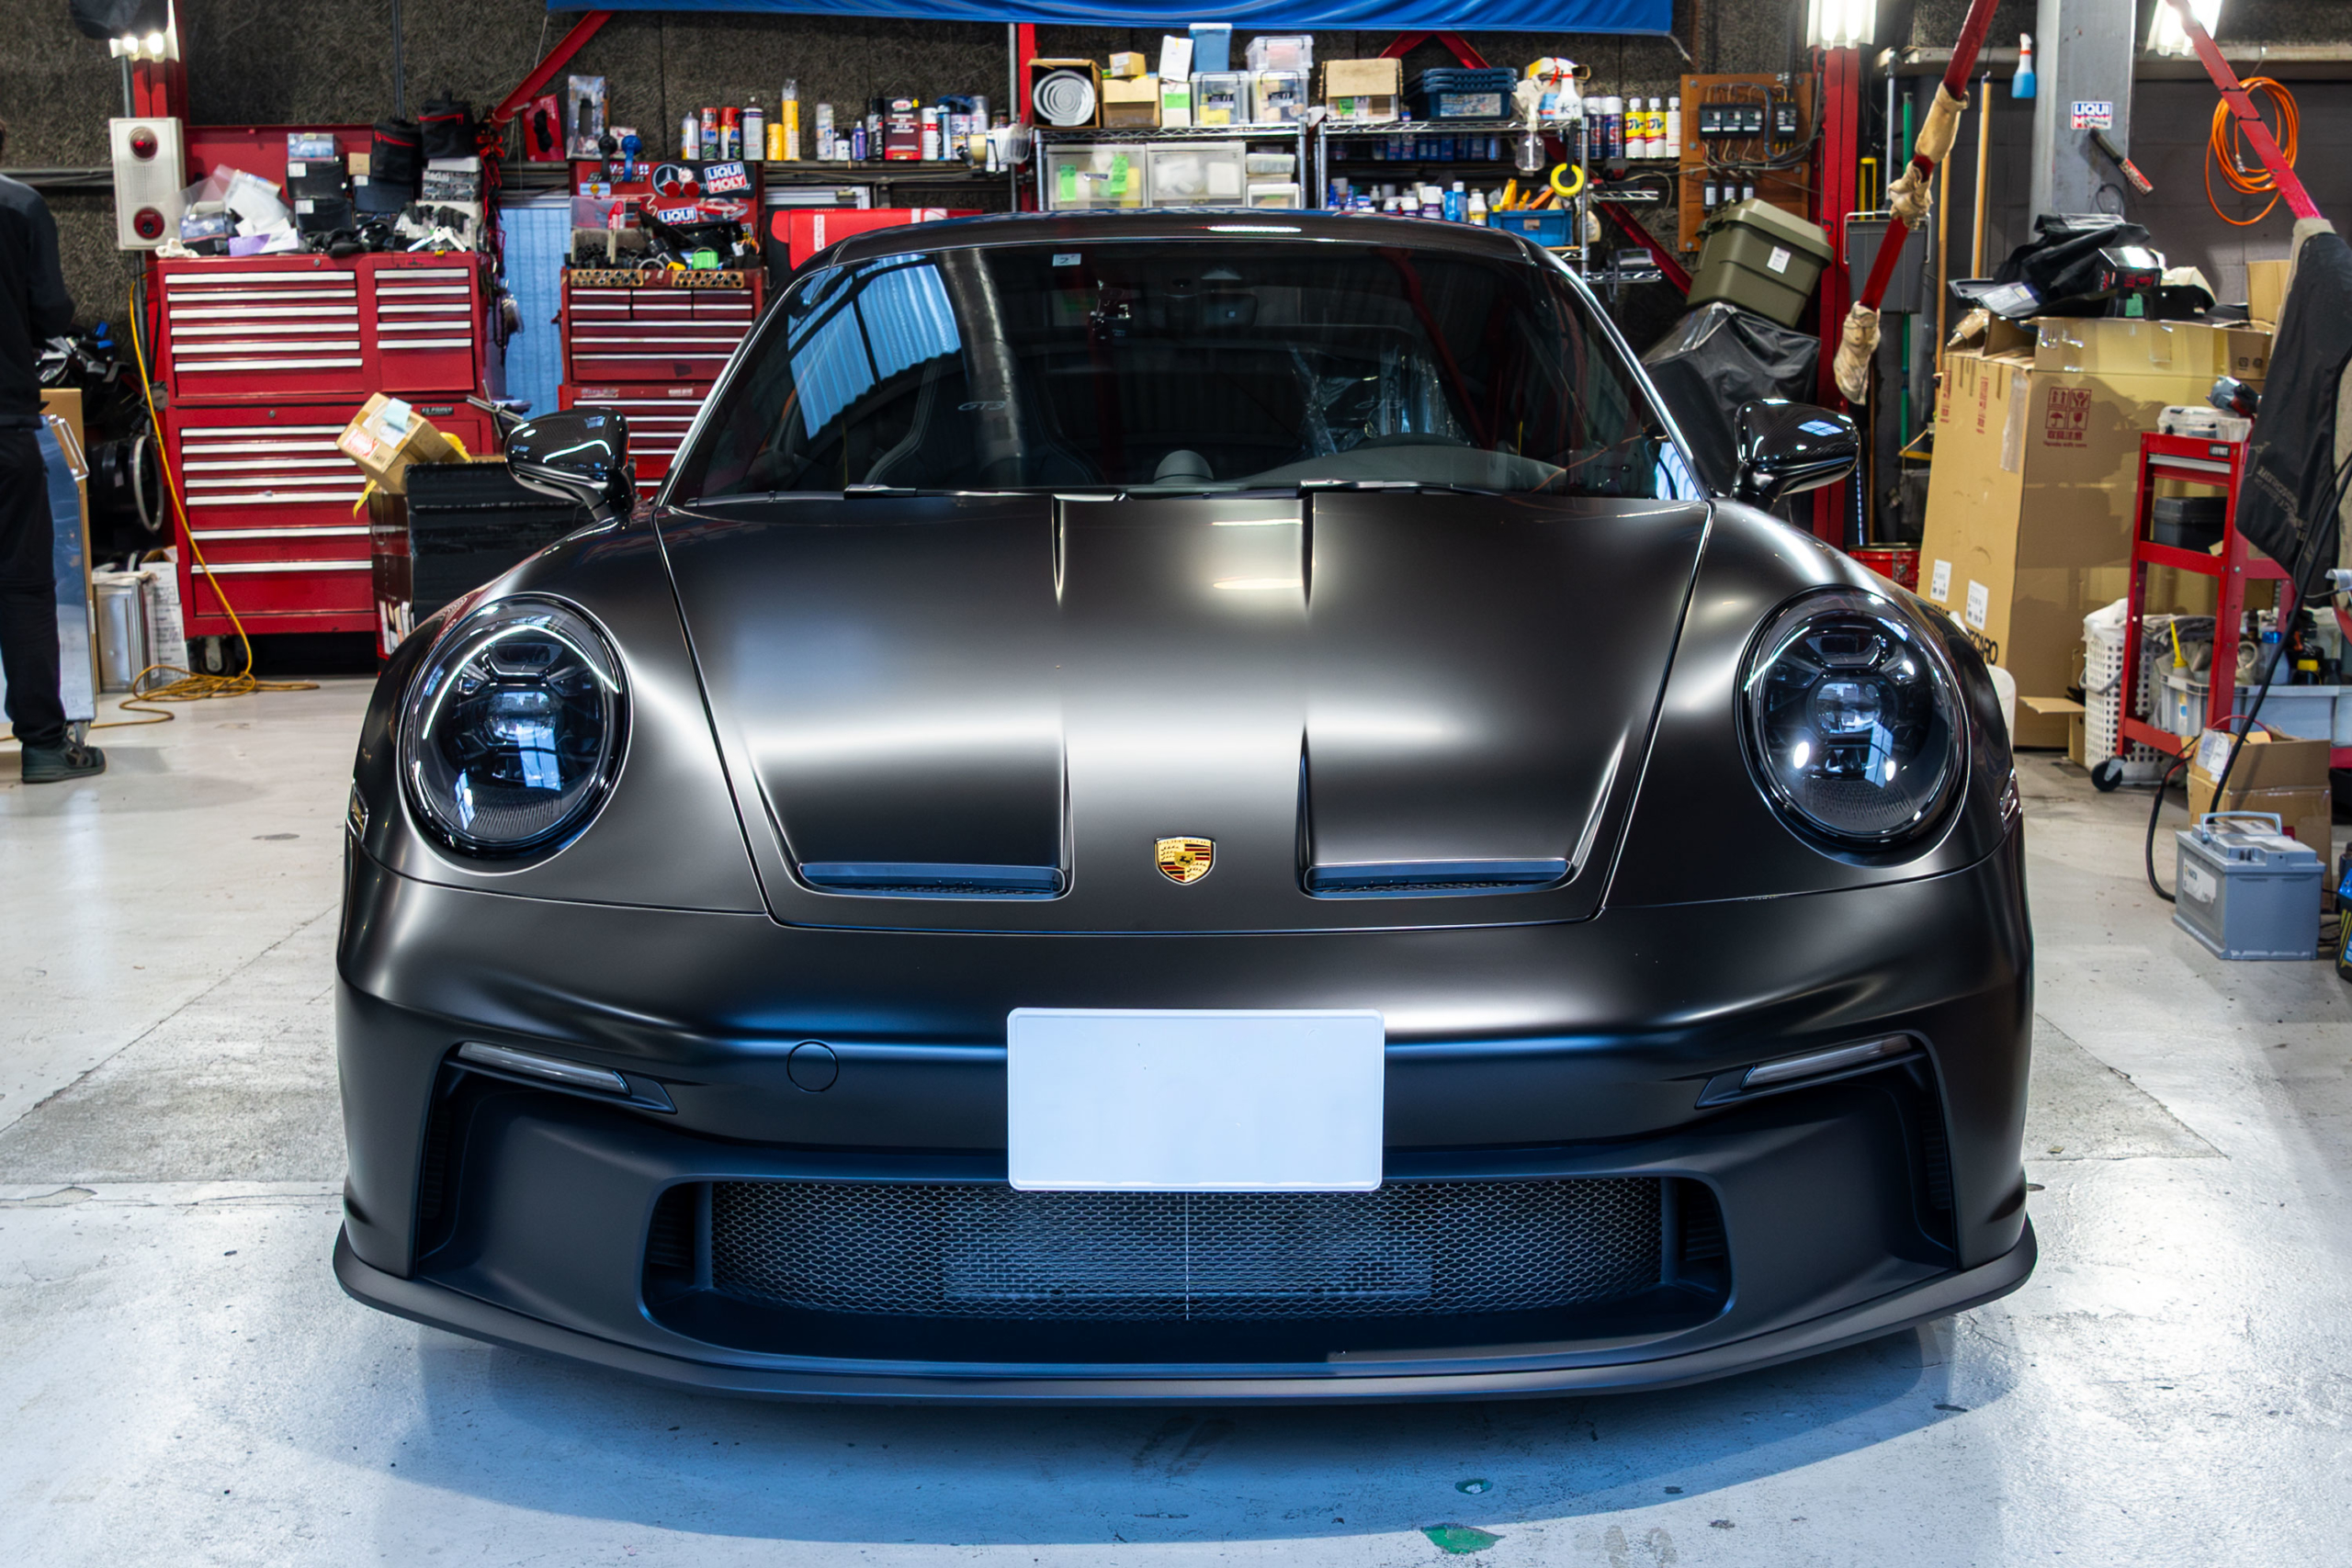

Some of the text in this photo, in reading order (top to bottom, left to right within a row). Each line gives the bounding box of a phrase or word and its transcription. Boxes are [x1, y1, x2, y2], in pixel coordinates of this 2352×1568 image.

[2074, 104, 2109, 116] LIQUI
[707, 163, 743, 180] LIQUI
[709, 176, 747, 194] MOLY
[661, 209, 696, 222] LIQUI
[958, 400, 1008, 412] GT3
